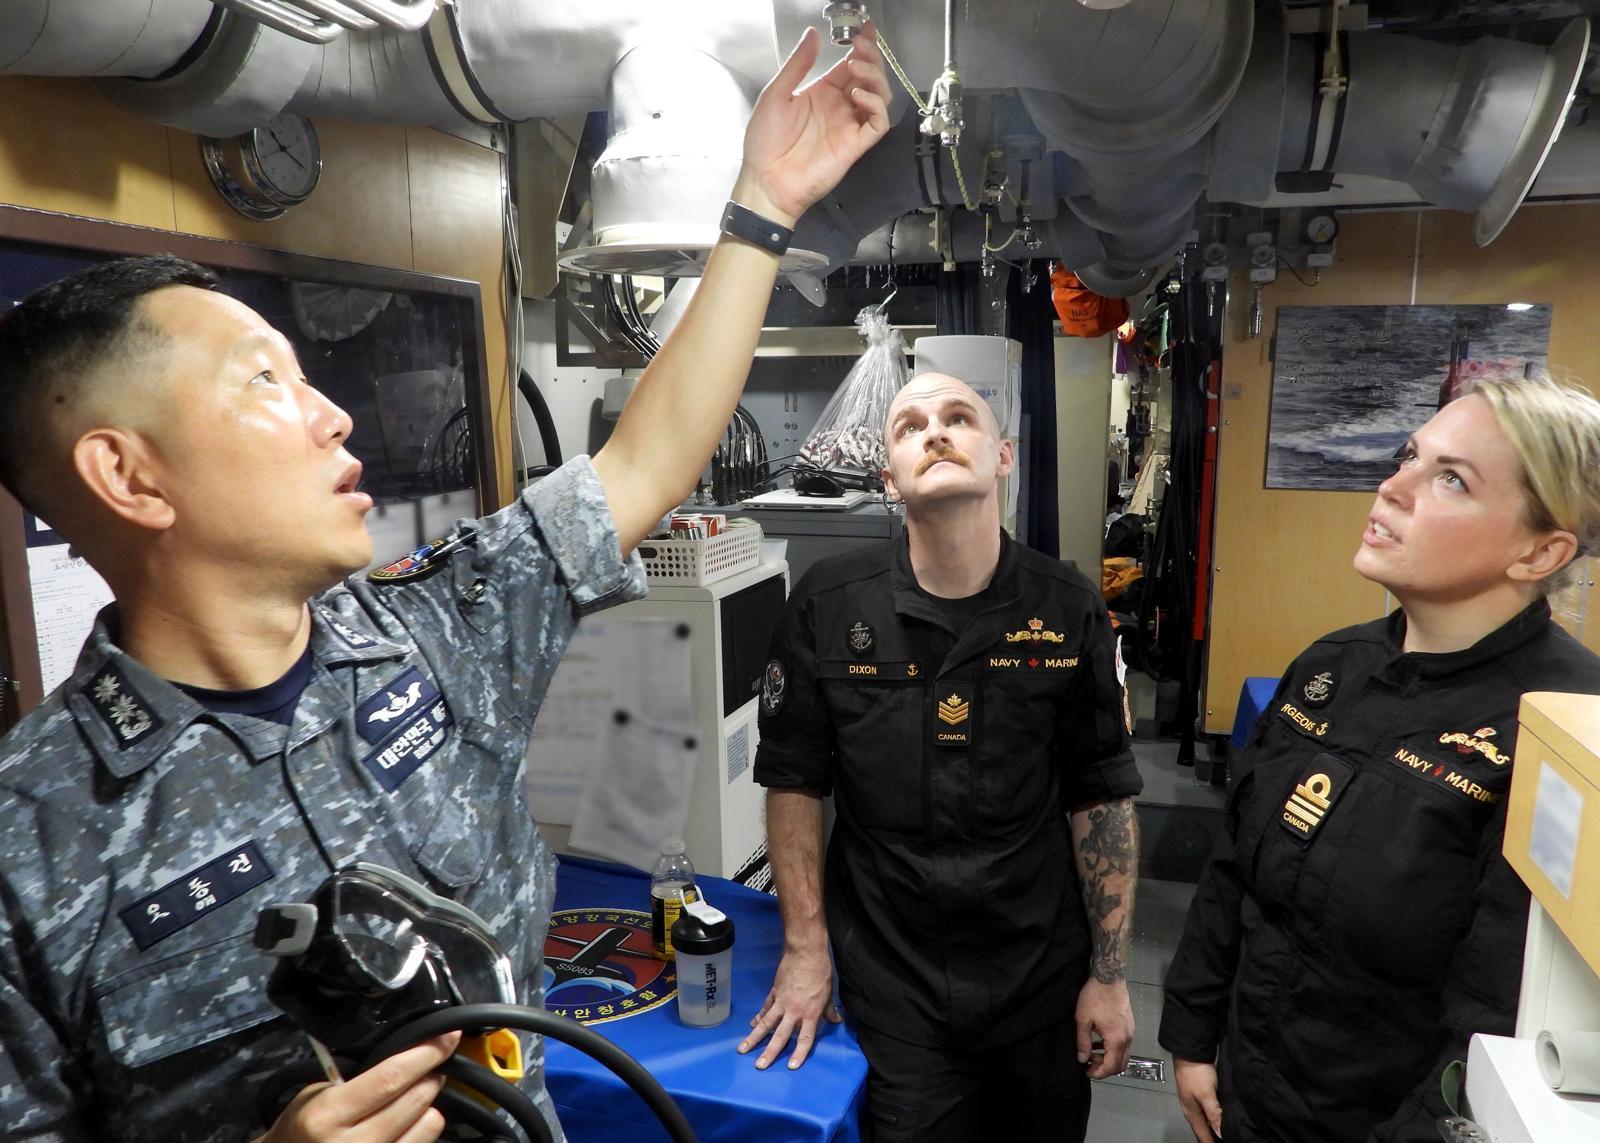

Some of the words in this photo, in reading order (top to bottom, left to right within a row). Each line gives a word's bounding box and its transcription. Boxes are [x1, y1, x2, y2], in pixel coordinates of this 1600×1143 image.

[990, 658, 1021, 668] NAVY
[849, 665, 877, 675] DIXON
[938, 733, 966, 741] CANADA
[1394, 748, 1433, 773] NAVY
[1283, 812, 1310, 833] CANADA
